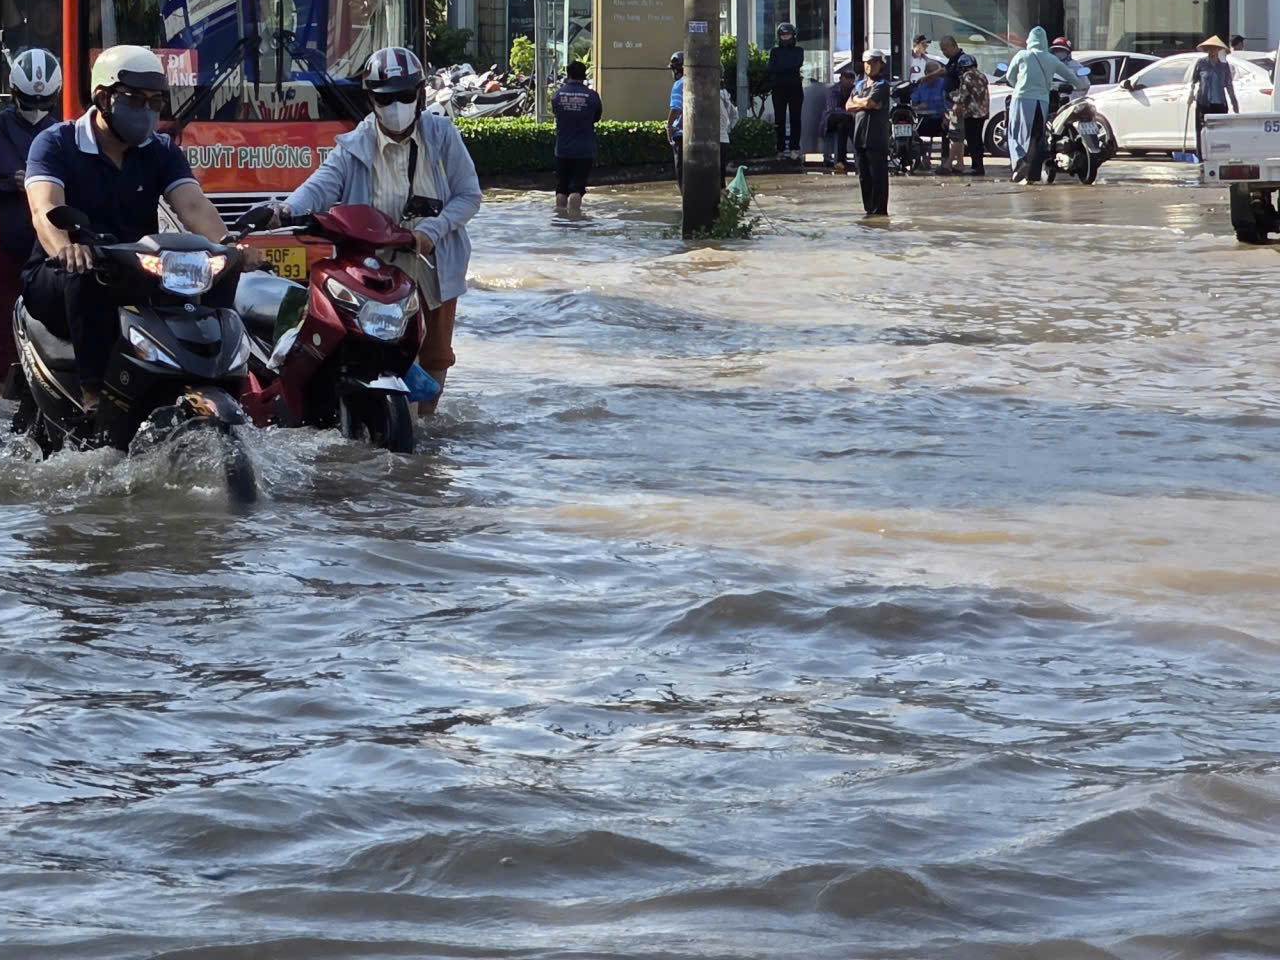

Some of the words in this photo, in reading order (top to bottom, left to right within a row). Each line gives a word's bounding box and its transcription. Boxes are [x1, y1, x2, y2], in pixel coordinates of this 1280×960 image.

[167, 53, 185, 69] ĐI
[1264, 120, 1280, 133] 65
[187, 144, 234, 168] BUÝT
[238, 143, 312, 169] PHƯƠNG
